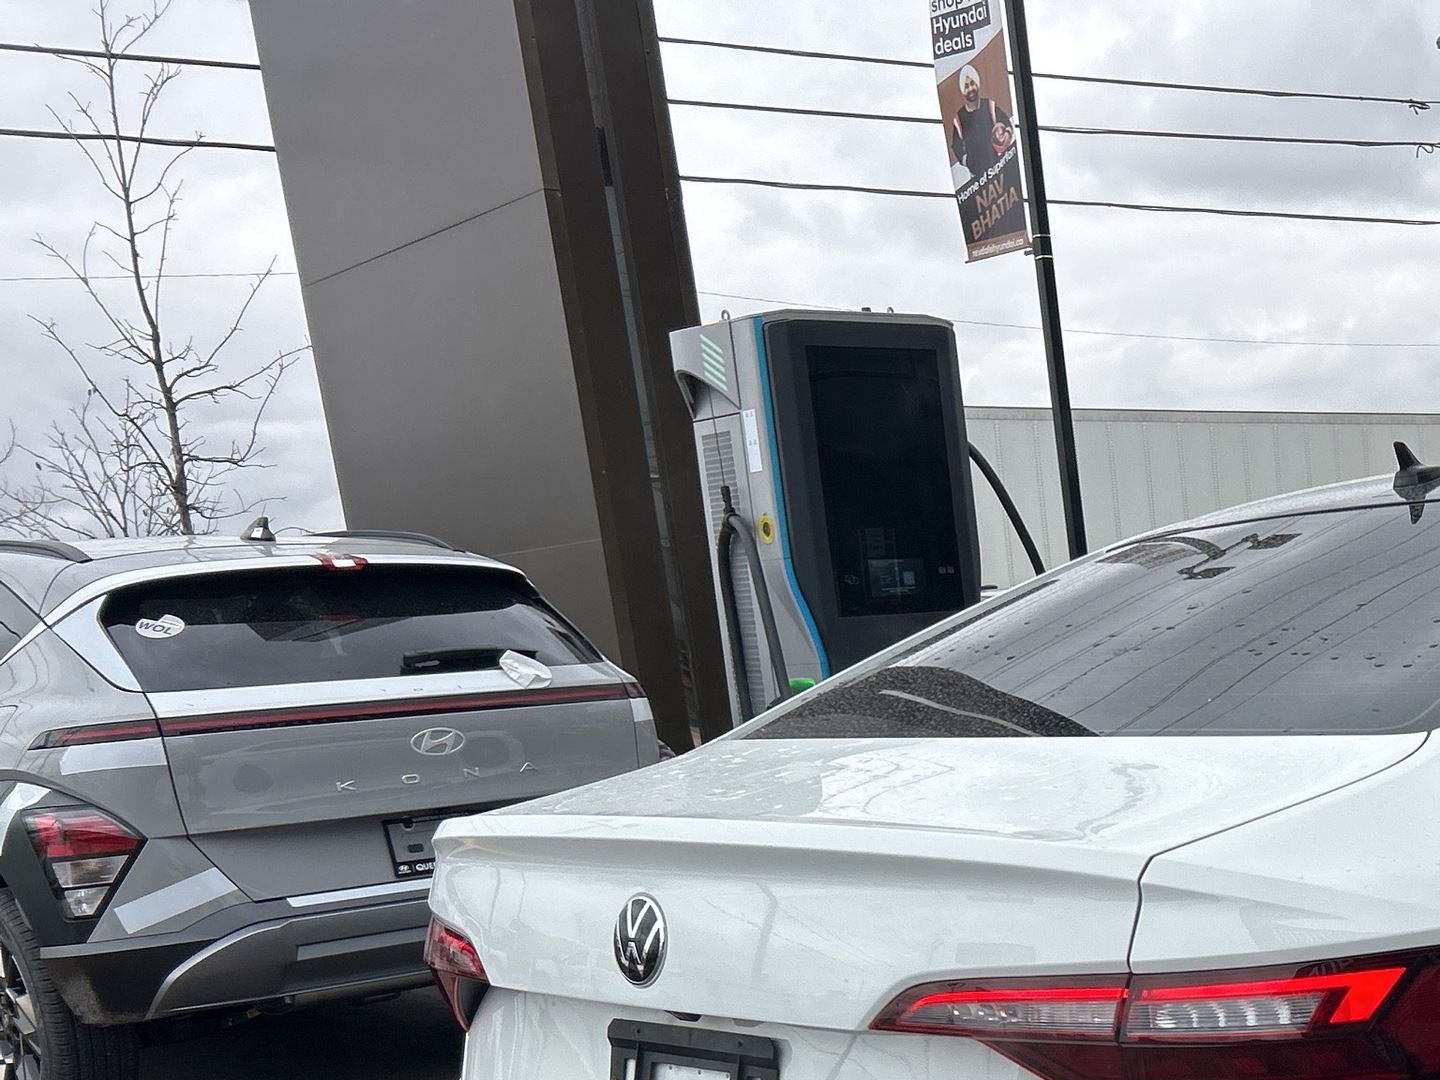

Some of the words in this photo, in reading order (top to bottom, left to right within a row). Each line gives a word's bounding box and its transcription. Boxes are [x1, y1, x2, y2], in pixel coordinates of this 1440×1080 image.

[932, 1, 988, 35] Hyundai
[934, 31, 973, 55] deals
[957, 181, 980, 204] Home
[980, 171, 988, 186] of
[987, 146, 1016, 179] Superfan
[975, 173, 1005, 213] NAV
[971, 186, 1019, 240] BHATIA
